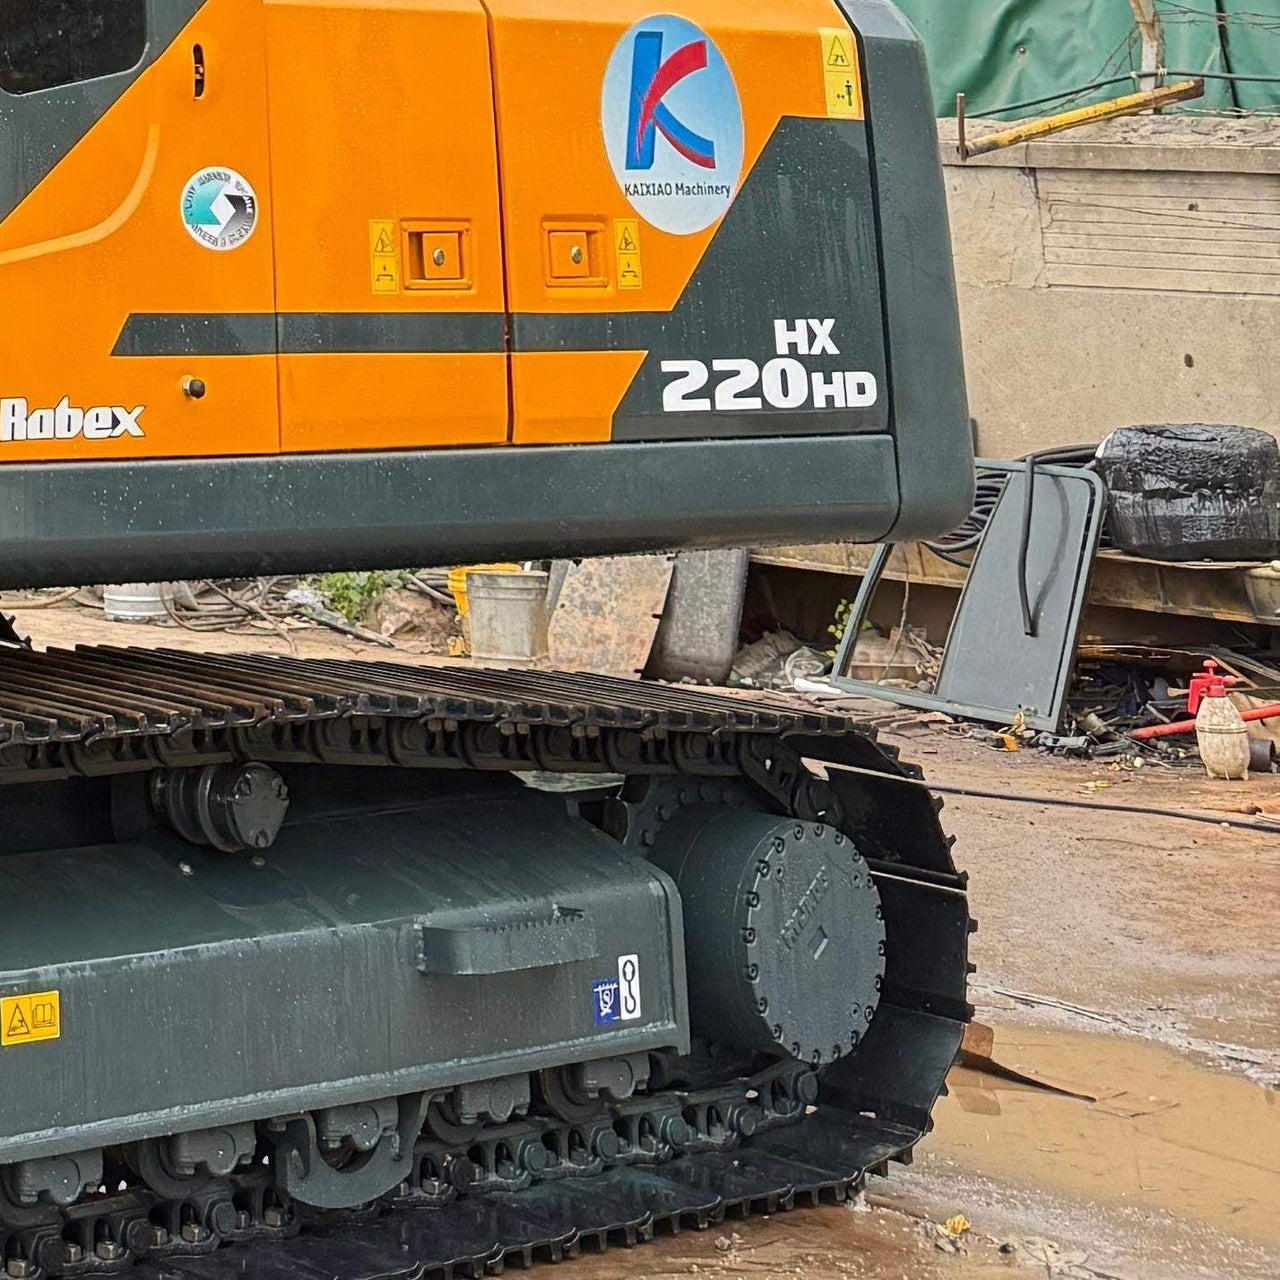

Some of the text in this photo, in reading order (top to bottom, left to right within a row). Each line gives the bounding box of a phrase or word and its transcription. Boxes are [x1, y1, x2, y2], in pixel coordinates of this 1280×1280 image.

[624, 182, 731, 198] KAIXIAO Machinery
[773, 318, 840, 355] HX
[660, 357, 878, 412] 220HD
